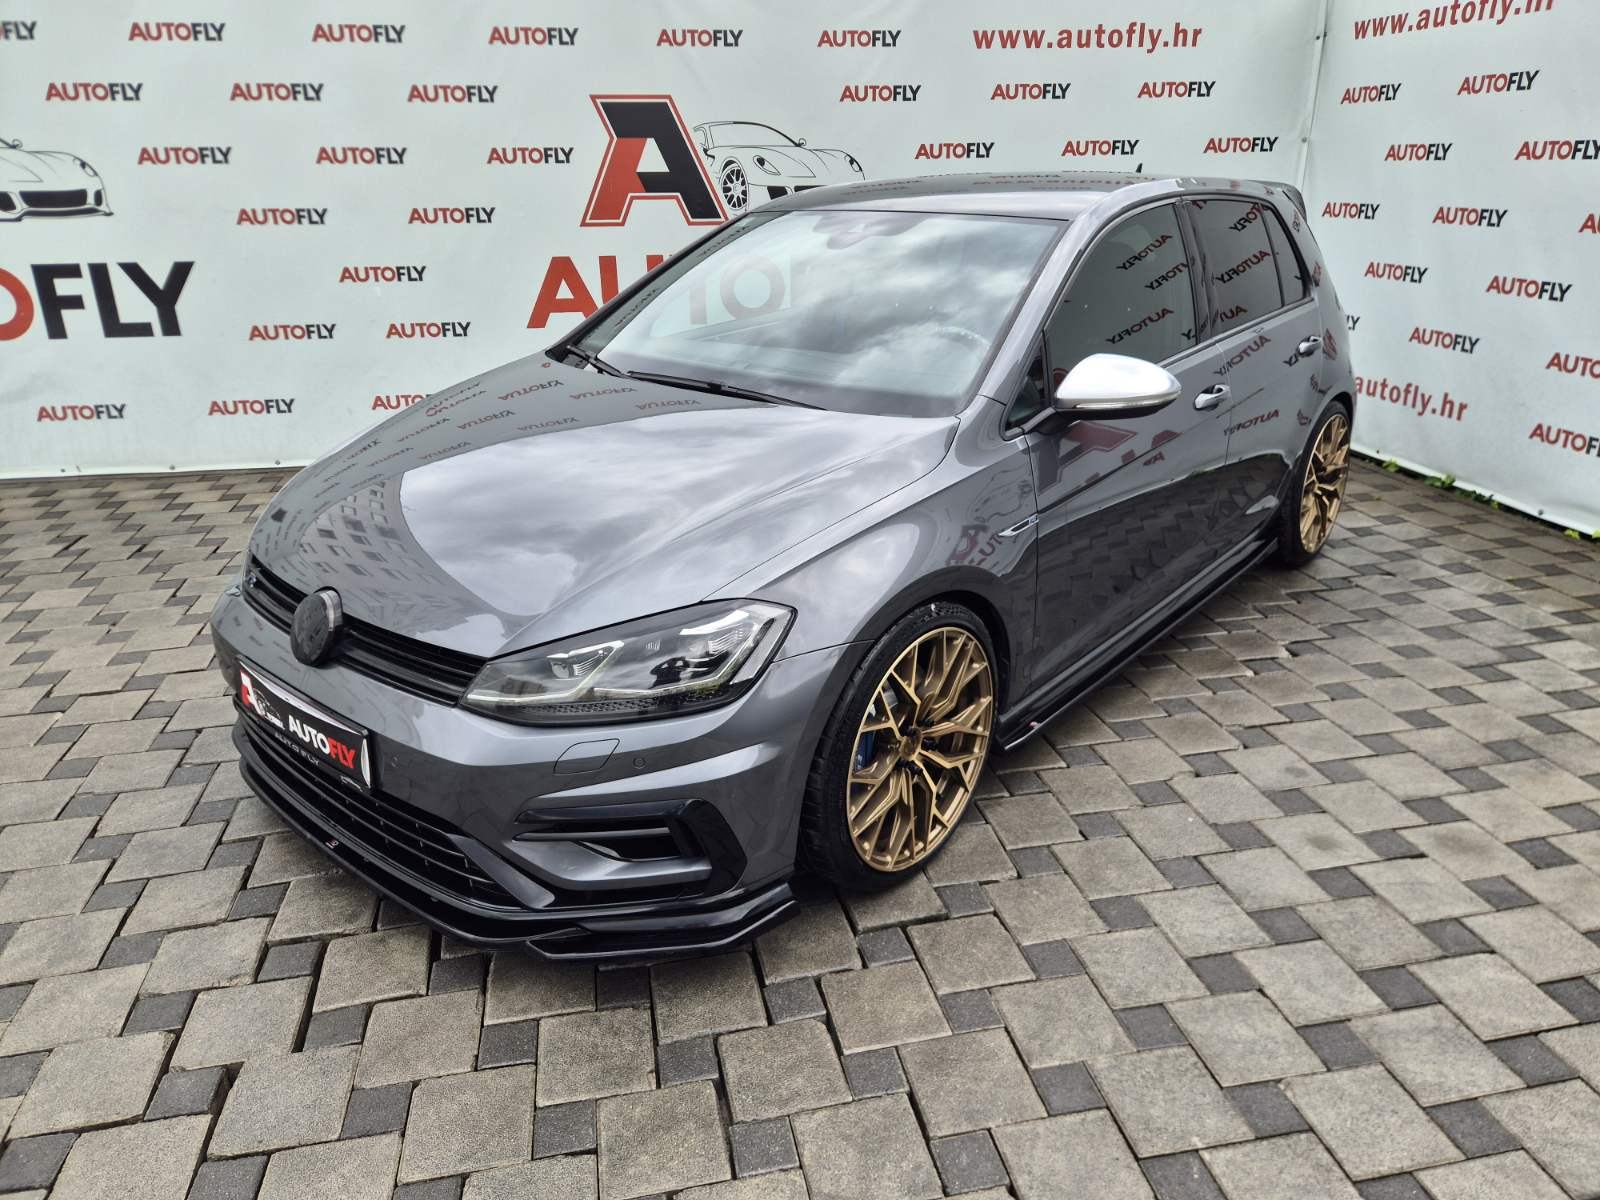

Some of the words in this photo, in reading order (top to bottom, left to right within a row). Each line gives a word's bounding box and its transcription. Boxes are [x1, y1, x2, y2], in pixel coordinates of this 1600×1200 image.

[0, 21, 37, 40] FLY
[128, 22, 225, 42] AUTOFLY
[312, 23, 406, 43] AUTOFLY
[488, 26, 579, 46] AUTOFLY
[656, 29, 743, 48] AUTOFLY
[817, 30, 902, 48] AUTOFLY
[973, 22, 1203, 54] www.autofly.hr
[46, 82, 144, 102] AUTOFLY
[230, 83, 324, 102] AUTOFLY
[991, 82, 1072, 101] AUTOFLY
[1136, 80, 1217, 98] AUTOFLY
[1456, 69, 1541, 96] AUTOFLY
[408, 84, 499, 104] AUTOFLY
[840, 84, 922, 103] AUTOFLY
[1340, 82, 1402, 105] AUTOFLY
[914, 141, 995, 160] AUTOFLY
[1061, 139, 1140, 157] AUTOFLY
[1202, 135, 1280, 154] AUTOFLY
[1383, 142, 1454, 162] AUTOFLY
[138, 146, 232, 166] AUTOFLY
[315, 146, 408, 165] AUTOFLY
[486, 146, 575, 165] AUTOFLY
[236, 207, 328, 226] AUTOFLY
[408, 206, 496, 225] AUTOFLY
[1321, 201, 1381, 221] AUTOFLY
[1432, 206, 1509, 228] AUTOFLY
[1578, 212, 1600, 235] A
[339, 265, 427, 284] AUTOFLY
[1364, 261, 1429, 285] AUTOFLY
[1485, 275, 1573, 303] AUTOFLY
[249, 323, 337, 342] AUTOFLY
[386, 321, 472, 340] AUTOFLY
[1408, 326, 1481, 355] AUTOFLY
[208, 397, 296, 417] AUTOFLY
[1355, 376, 1469, 422] autofly.hr
[37, 403, 127, 423] AUTOFLY
[1528, 422, 1600, 458] AUTOF
[288, 714, 356, 769] AUTOFLY
